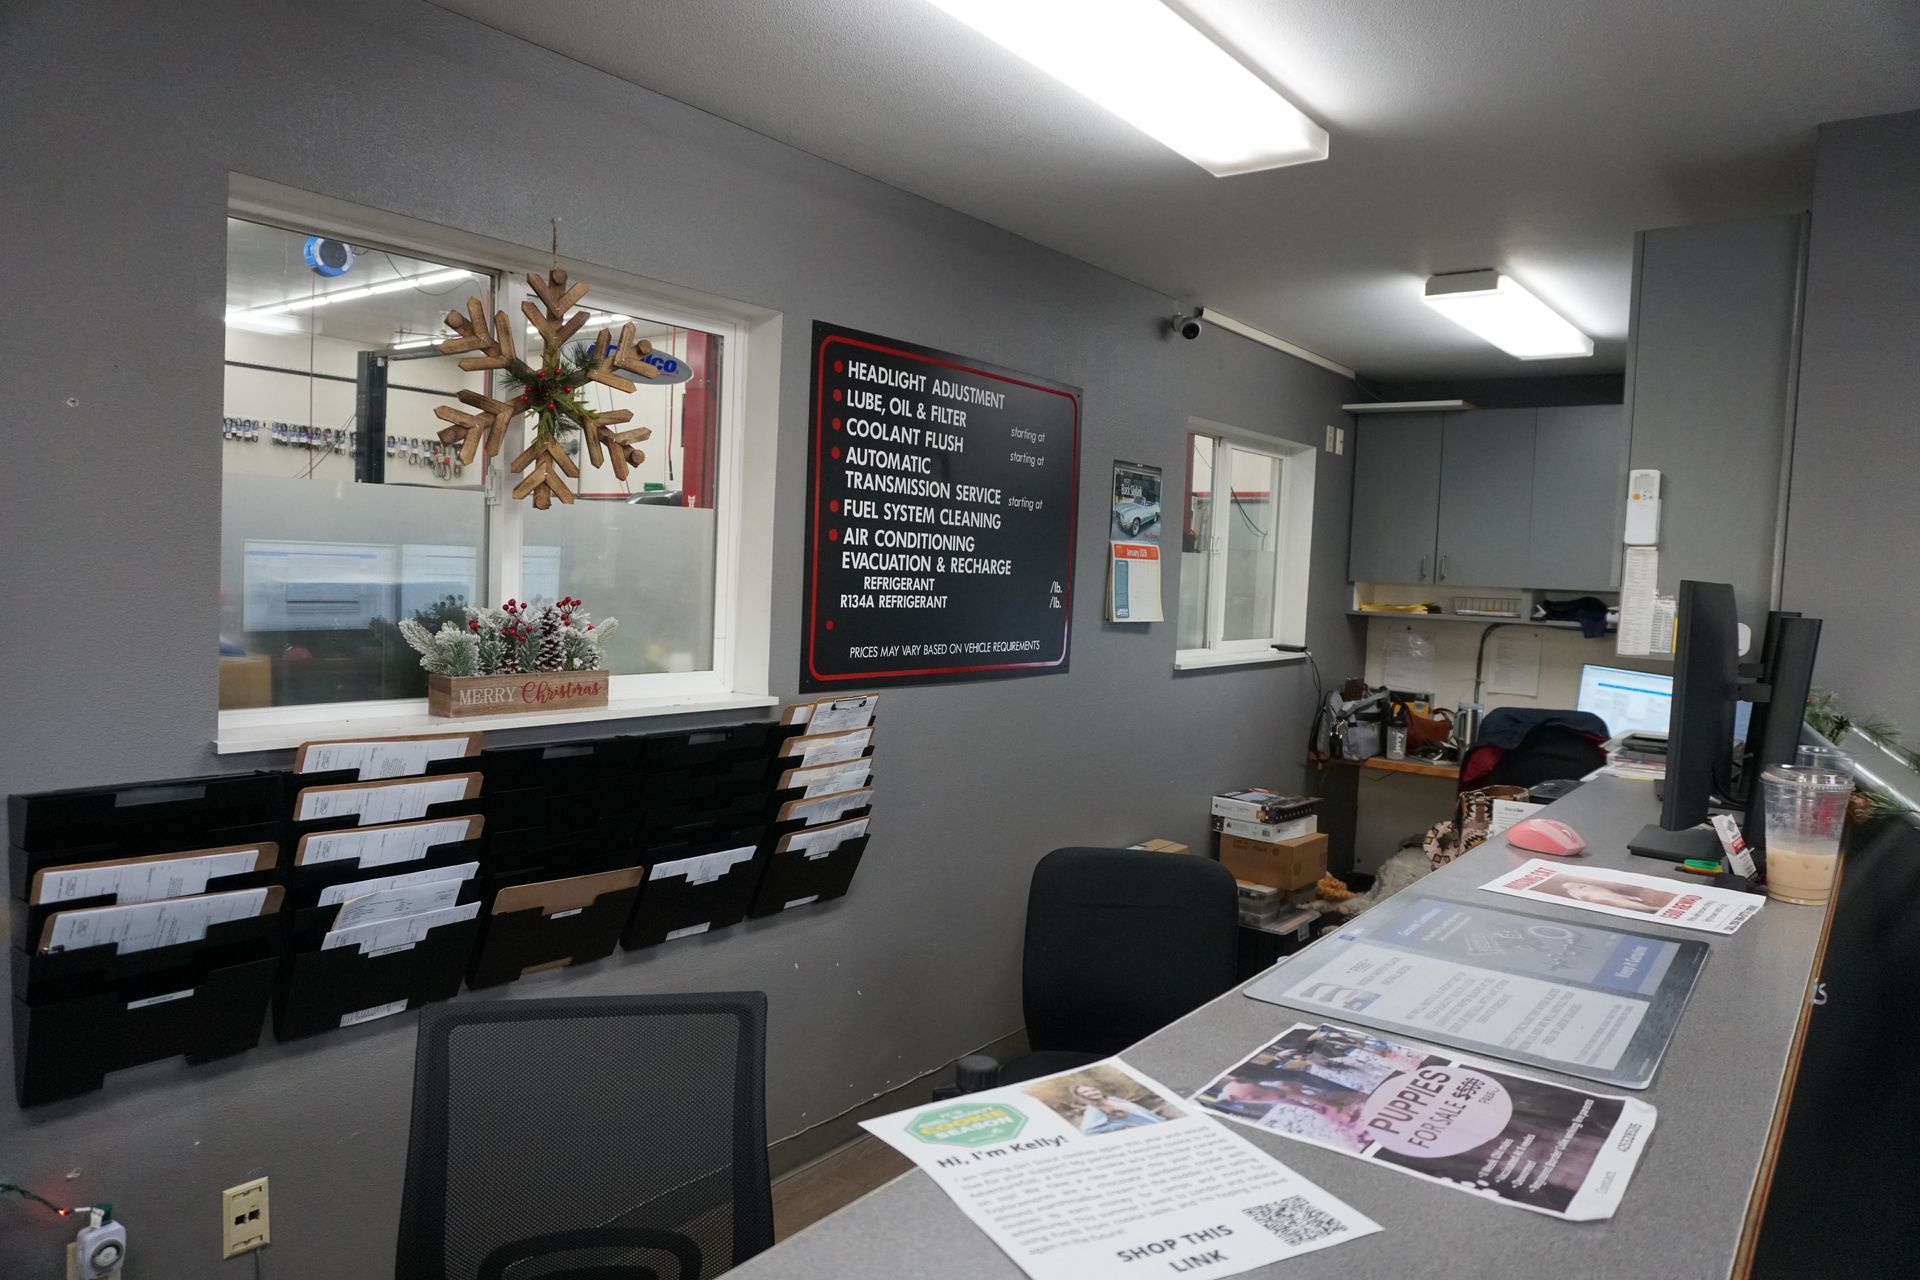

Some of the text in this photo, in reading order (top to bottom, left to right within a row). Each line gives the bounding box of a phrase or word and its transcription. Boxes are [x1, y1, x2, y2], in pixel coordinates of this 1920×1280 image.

[848, 360, 1005, 410] HEADLIGHT ADJUSTMENT
[847, 389, 967, 428] LUBE, OIL & FILTER
[846, 418, 964, 453] COOLANT FLUSH
[1011, 427, 1046, 444] starting at
[846, 447, 931, 475] AUTOMATIC
[1009, 452, 1045, 467] starting at
[845, 470, 1001, 505] TRANSMISSION SERVICE
[843, 499, 1002, 530] FUEL SYSTEM CLEANING
[1008, 497, 1043, 512] starting at
[843, 528, 975, 552] AIR CONDITIONING
[842, 552, 1012, 575] EVACUATION & RECHARGE
[864, 576, 935, 591] REFRIGERANT
[840, 594, 948, 609] R134A REFRIGERANT
[850, 640, 1040, 659] PRICES MAY VARY BASED ON VEHICLE REQUIREMENTS
[459, 681, 602, 706] MERRY Christmas
[1368, 1068, 1451, 1135] PUPPIES
[935, 1116, 1014, 1140] SEASON
[1407, 1119, 1447, 1150] FOR
[1429, 1098, 1467, 1126] SALE
[938, 1154, 970, 1169] Hi,
[973, 1144, 1008, 1163] I'm
[1011, 1134, 1069, 1156] Kelly!
[1117, 1224, 1233, 1263] SHOP THIS
[1169, 1249, 1230, 1273] LINK
